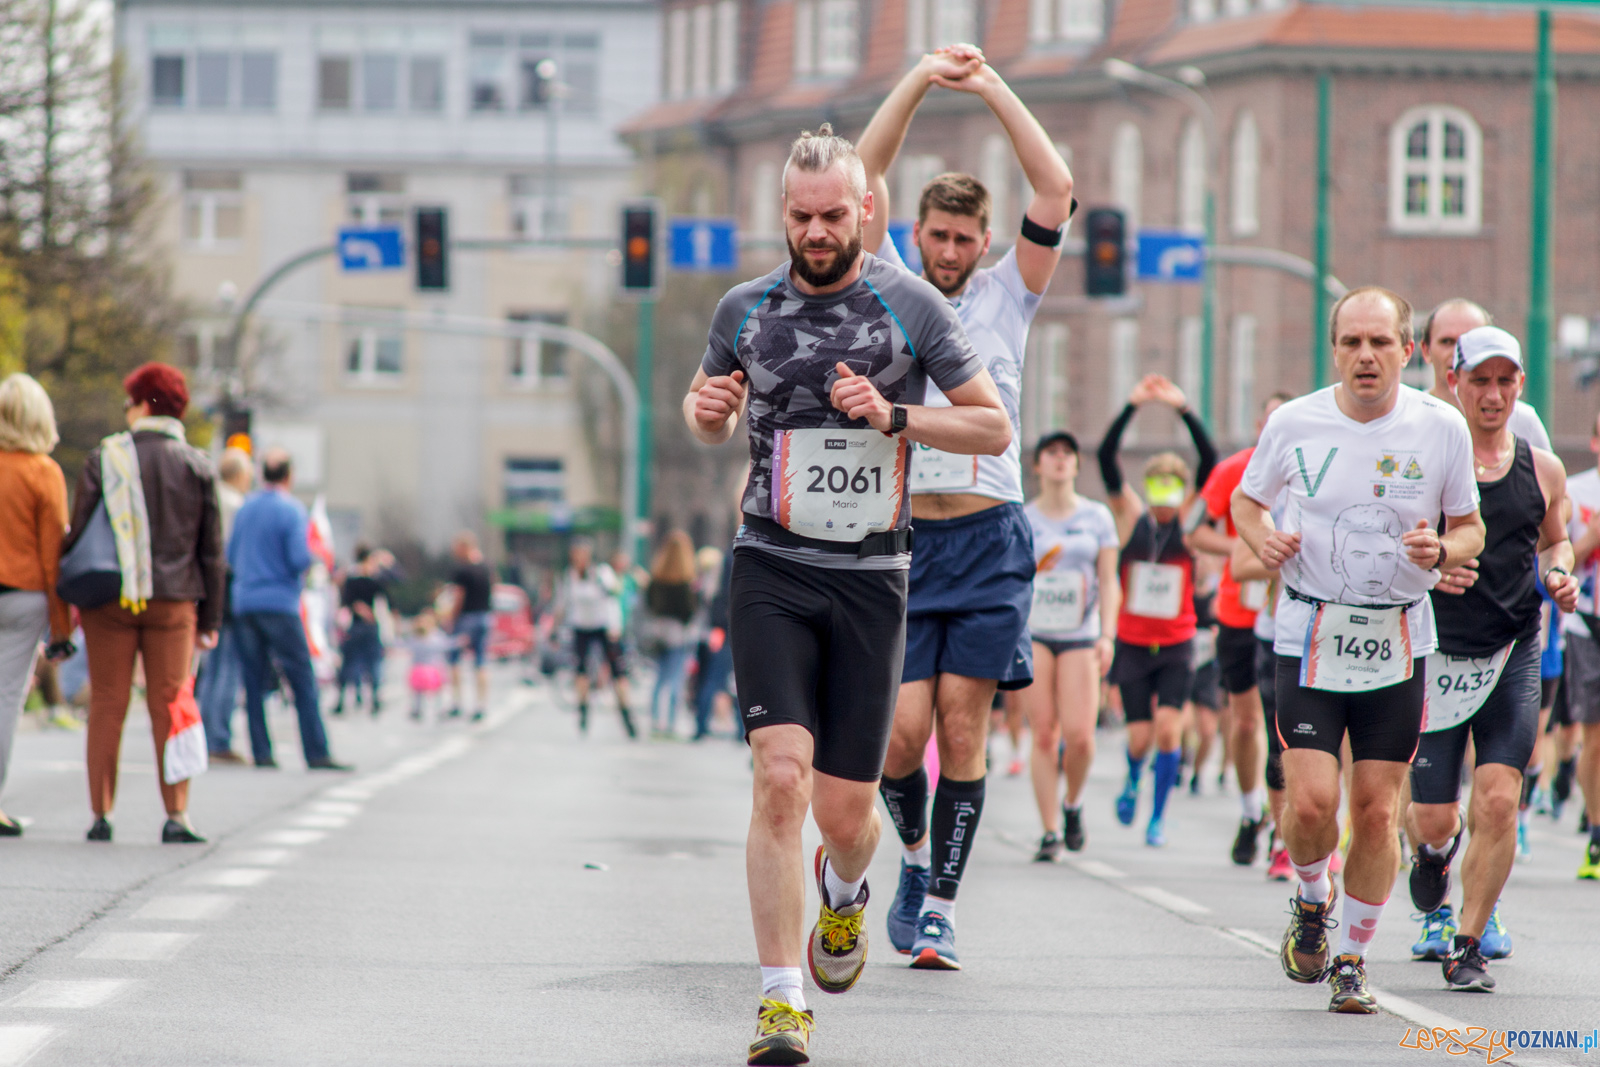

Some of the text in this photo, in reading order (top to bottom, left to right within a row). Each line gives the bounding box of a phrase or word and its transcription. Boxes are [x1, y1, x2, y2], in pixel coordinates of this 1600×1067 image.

[806, 465, 882, 494] 2061
[832, 500, 858, 509] Mario
[1333, 634, 1392, 661] 1498
[1437, 668, 1496, 696] 9432
